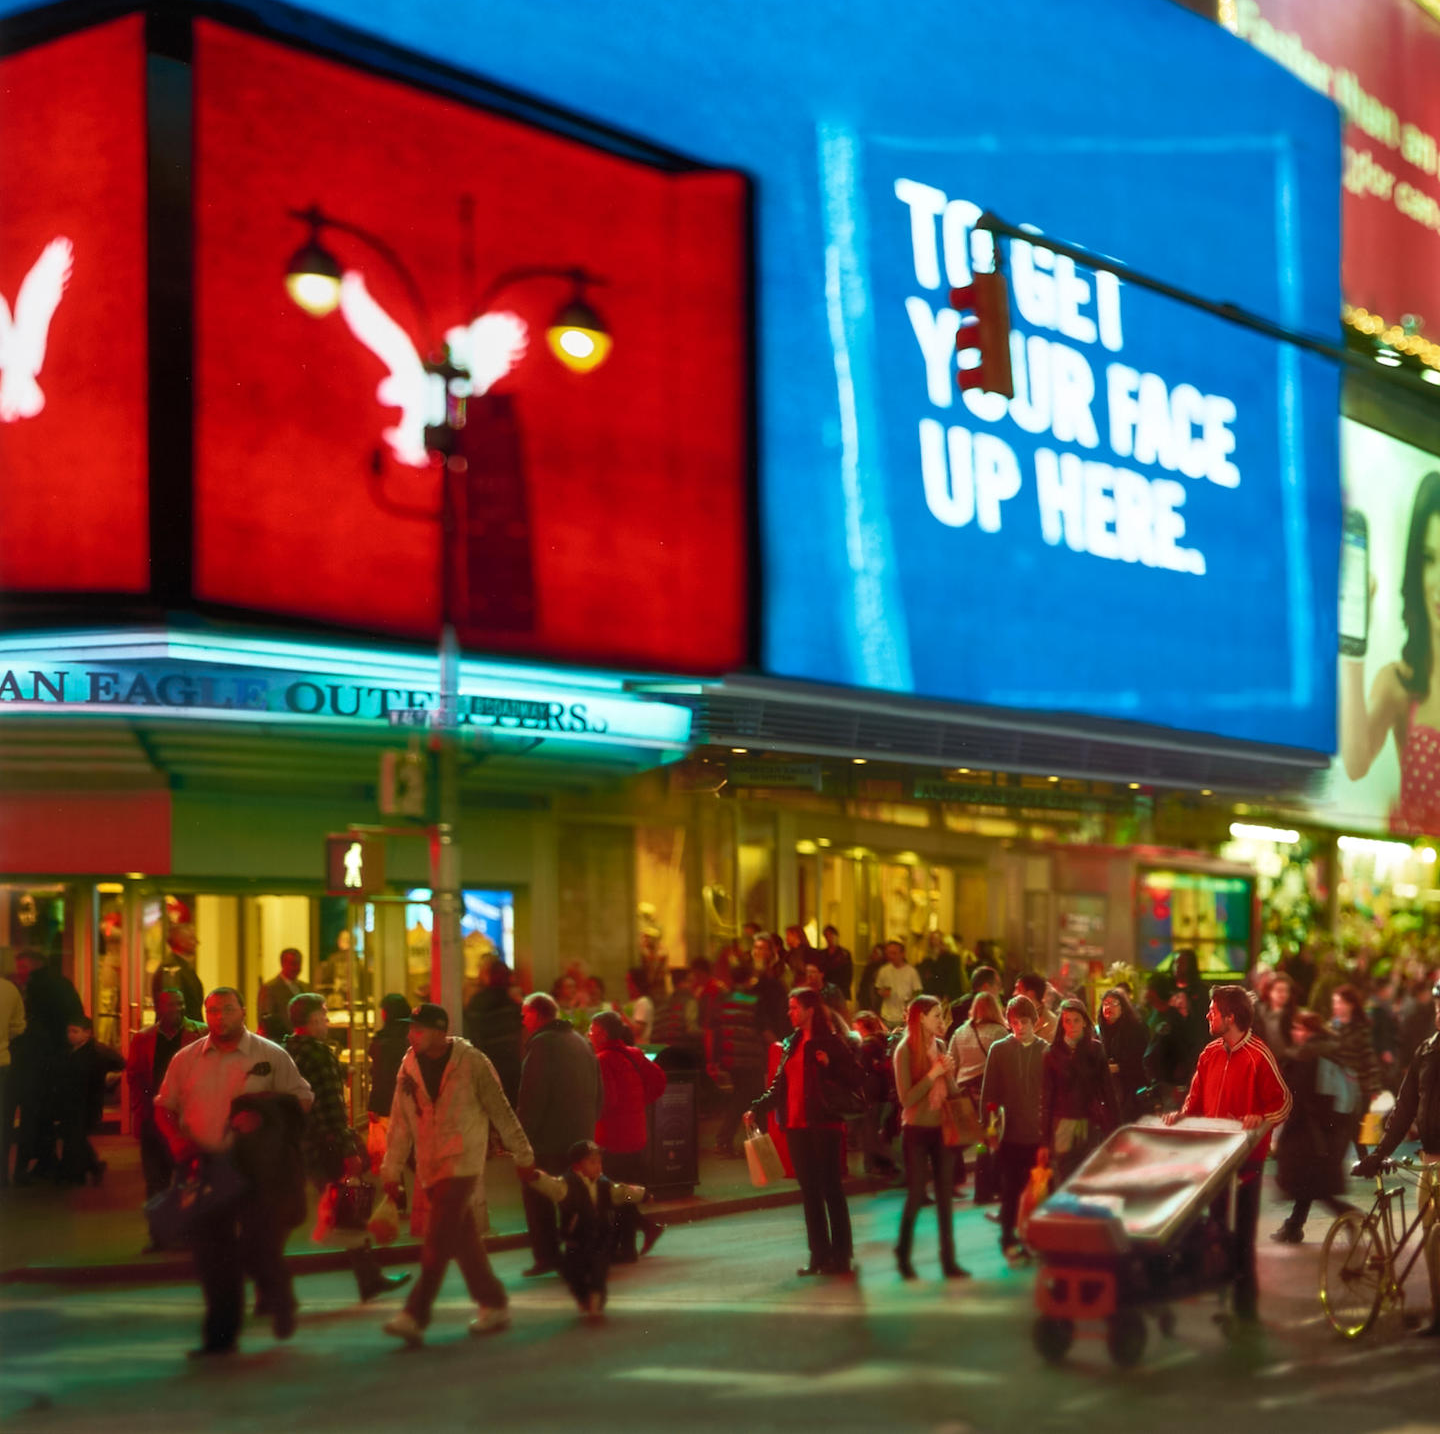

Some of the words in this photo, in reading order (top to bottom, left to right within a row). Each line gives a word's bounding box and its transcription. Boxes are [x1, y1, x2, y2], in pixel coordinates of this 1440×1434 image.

[895, 178, 985, 292] TO
[1008, 224, 1124, 352] GET
[905, 296, 1098, 450] YOUR
[1108, 364, 1240, 490] FACE
[918, 418, 1018, 532] UP
[1036, 452, 1207, 578] HERE.
[86, 671, 268, 709] EAGLE
